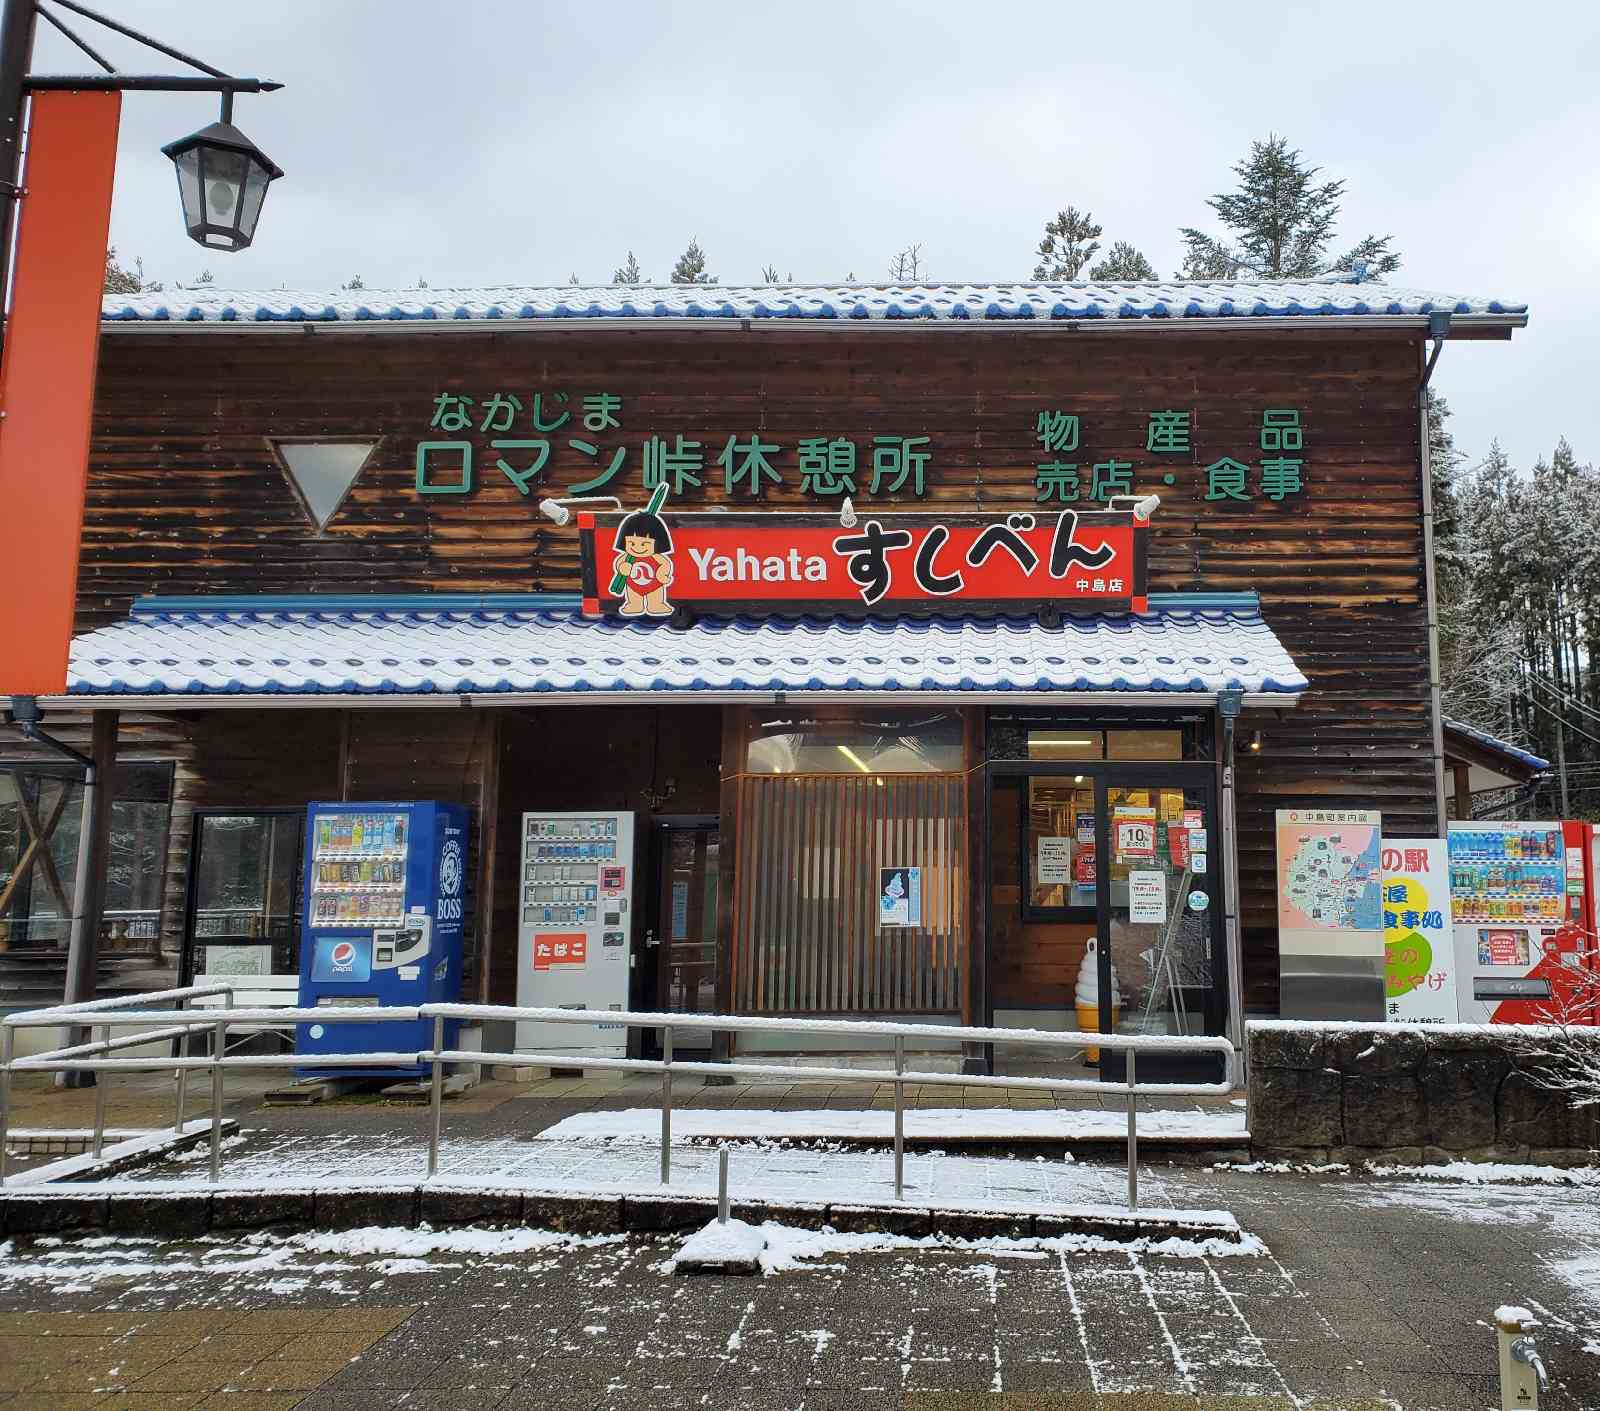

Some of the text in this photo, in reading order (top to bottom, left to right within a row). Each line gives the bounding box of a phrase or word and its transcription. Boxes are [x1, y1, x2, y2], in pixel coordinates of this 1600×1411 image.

[431, 392, 621, 432] なかじま
[415, 435, 930, 496] ロマン峠休憩所
[688, 509, 1117, 605] Yahata すしべん
[1075, 578, 1124, 592] 中島店
[1383, 885, 1408, 903] 屋
[437, 899, 461, 919] BOSS
[536, 943, 584, 957] たばこ
